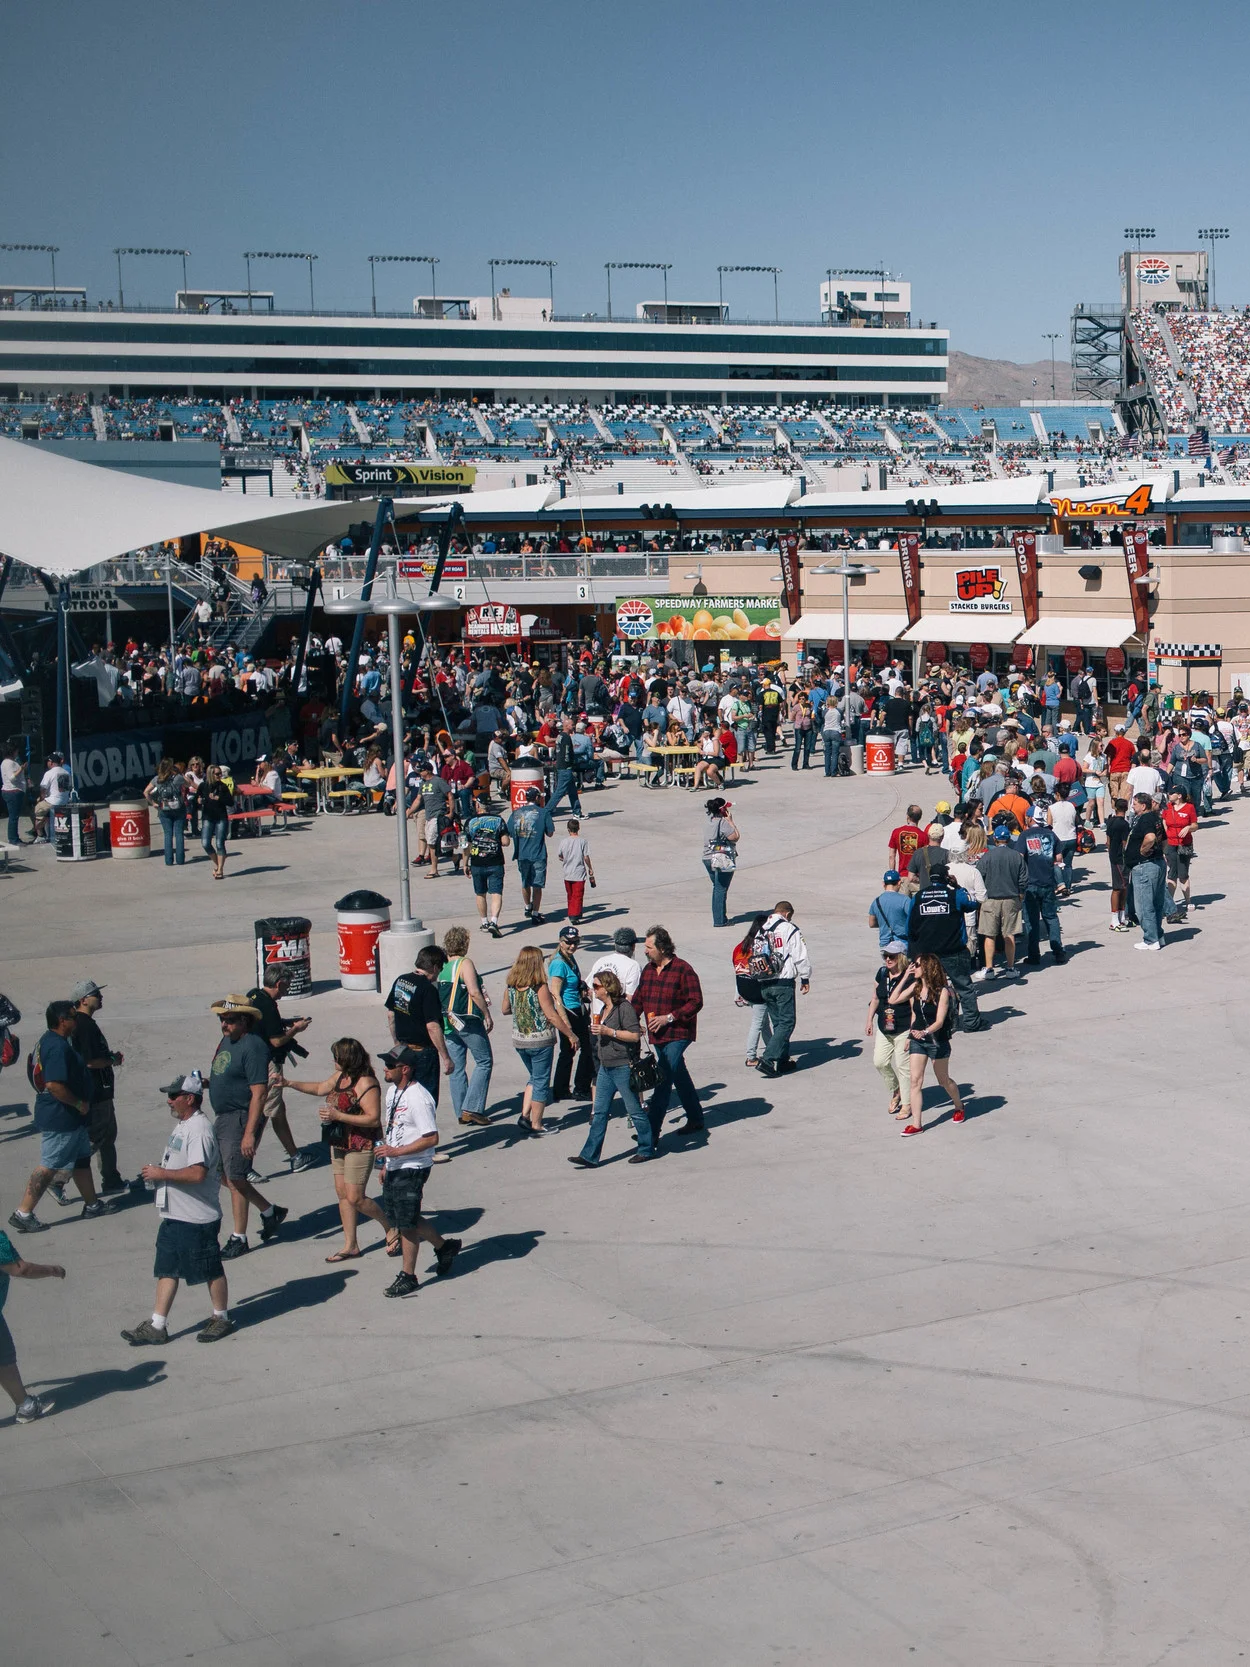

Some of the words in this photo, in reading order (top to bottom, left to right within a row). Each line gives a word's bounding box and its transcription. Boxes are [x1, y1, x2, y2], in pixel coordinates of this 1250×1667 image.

[355, 468, 392, 484] Sprint
[419, 469, 464, 481] Vision
[1050, 497, 1132, 517] Neon
[1124, 484, 1153, 515] 4
[900, 538, 913, 588] DRINKS
[1016, 536, 1028, 574] FOOD
[1124, 535, 1137, 574] BEER
[780, 539, 794, 591] SNACKS
[957, 569, 998, 586] PILE
[71, 590, 112, 600] MEN'S
[456, 588, 463, 599] 2
[579, 587, 586, 598] 3
[958, 580, 1003, 600] UP!
[44, 600, 119, 611] RTROOM
[655, 599, 701, 609] SPEEDWAY
[703, 599, 745, 609] FARMERS
[490, 623, 519, 635] HERE!
[210, 726, 273, 765] KOBA
[74, 741, 164, 789] KOBALT
